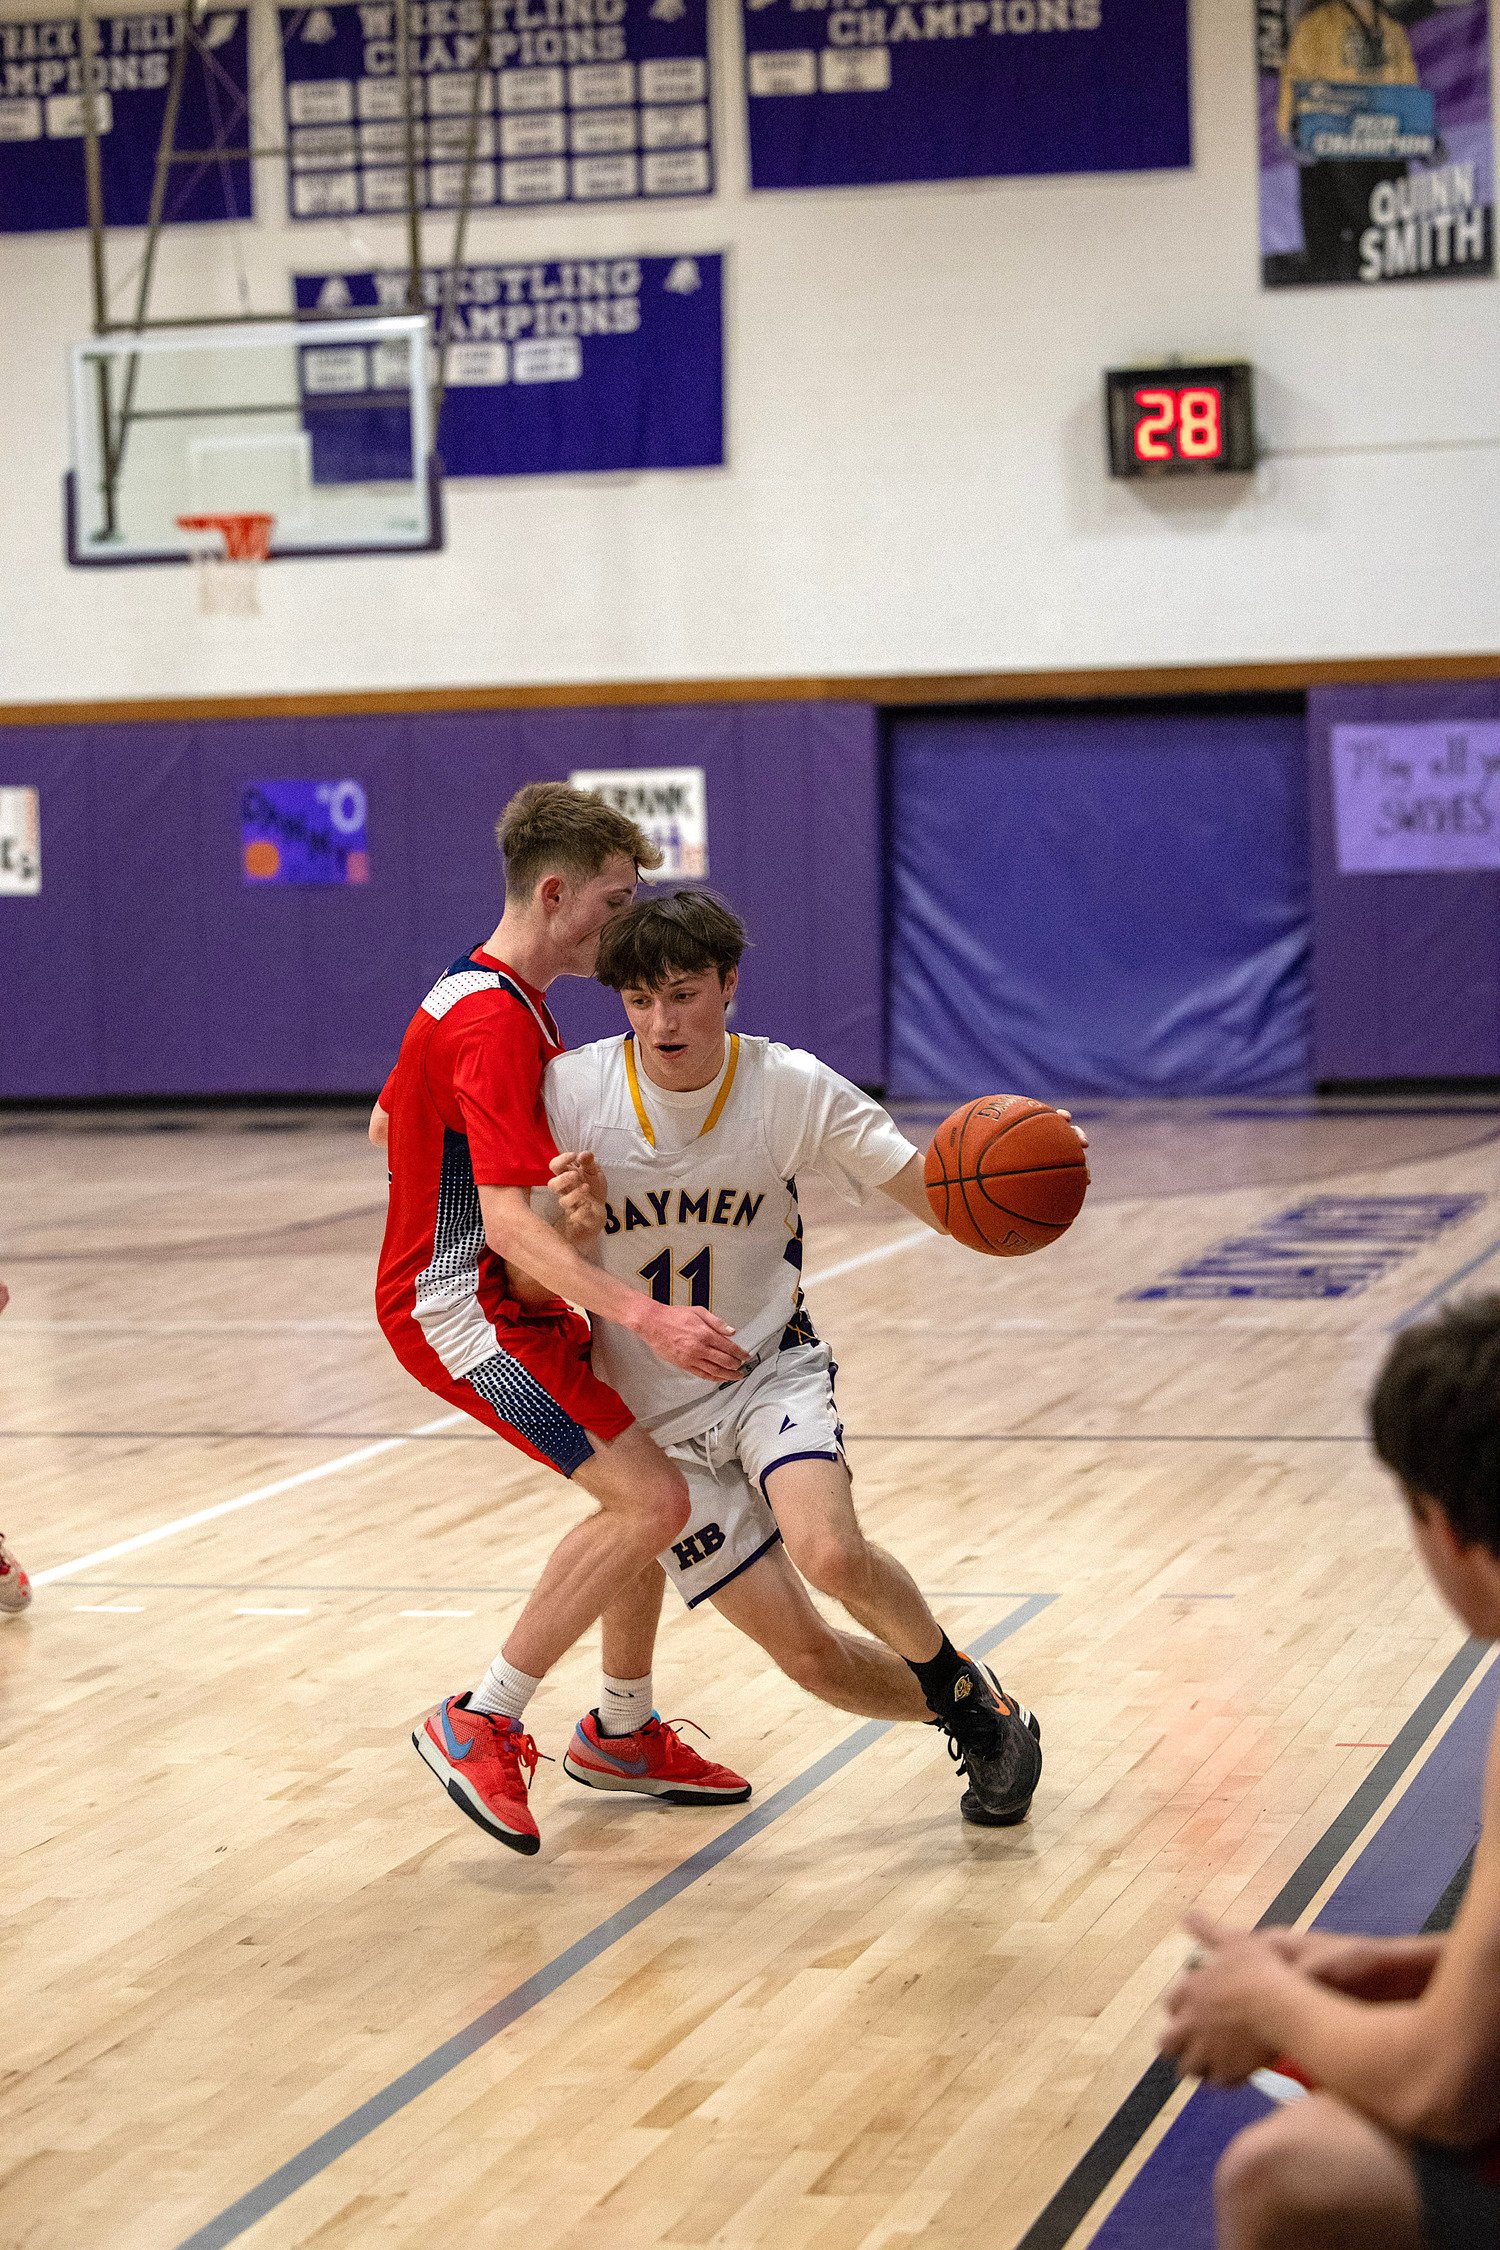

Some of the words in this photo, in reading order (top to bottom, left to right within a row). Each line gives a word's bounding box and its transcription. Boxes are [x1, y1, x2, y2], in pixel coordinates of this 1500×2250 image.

[828, 0, 1103, 46] CHAMPIONS
[0, 54, 170, 96] MPIONS
[1359, 205, 1484, 281] SMITH
[1134, 387, 1221, 460] 28
[603, 1186, 767, 1236] BAYMEN
[636, 1244, 713, 1313] 11
[670, 1522, 726, 1572] HB
